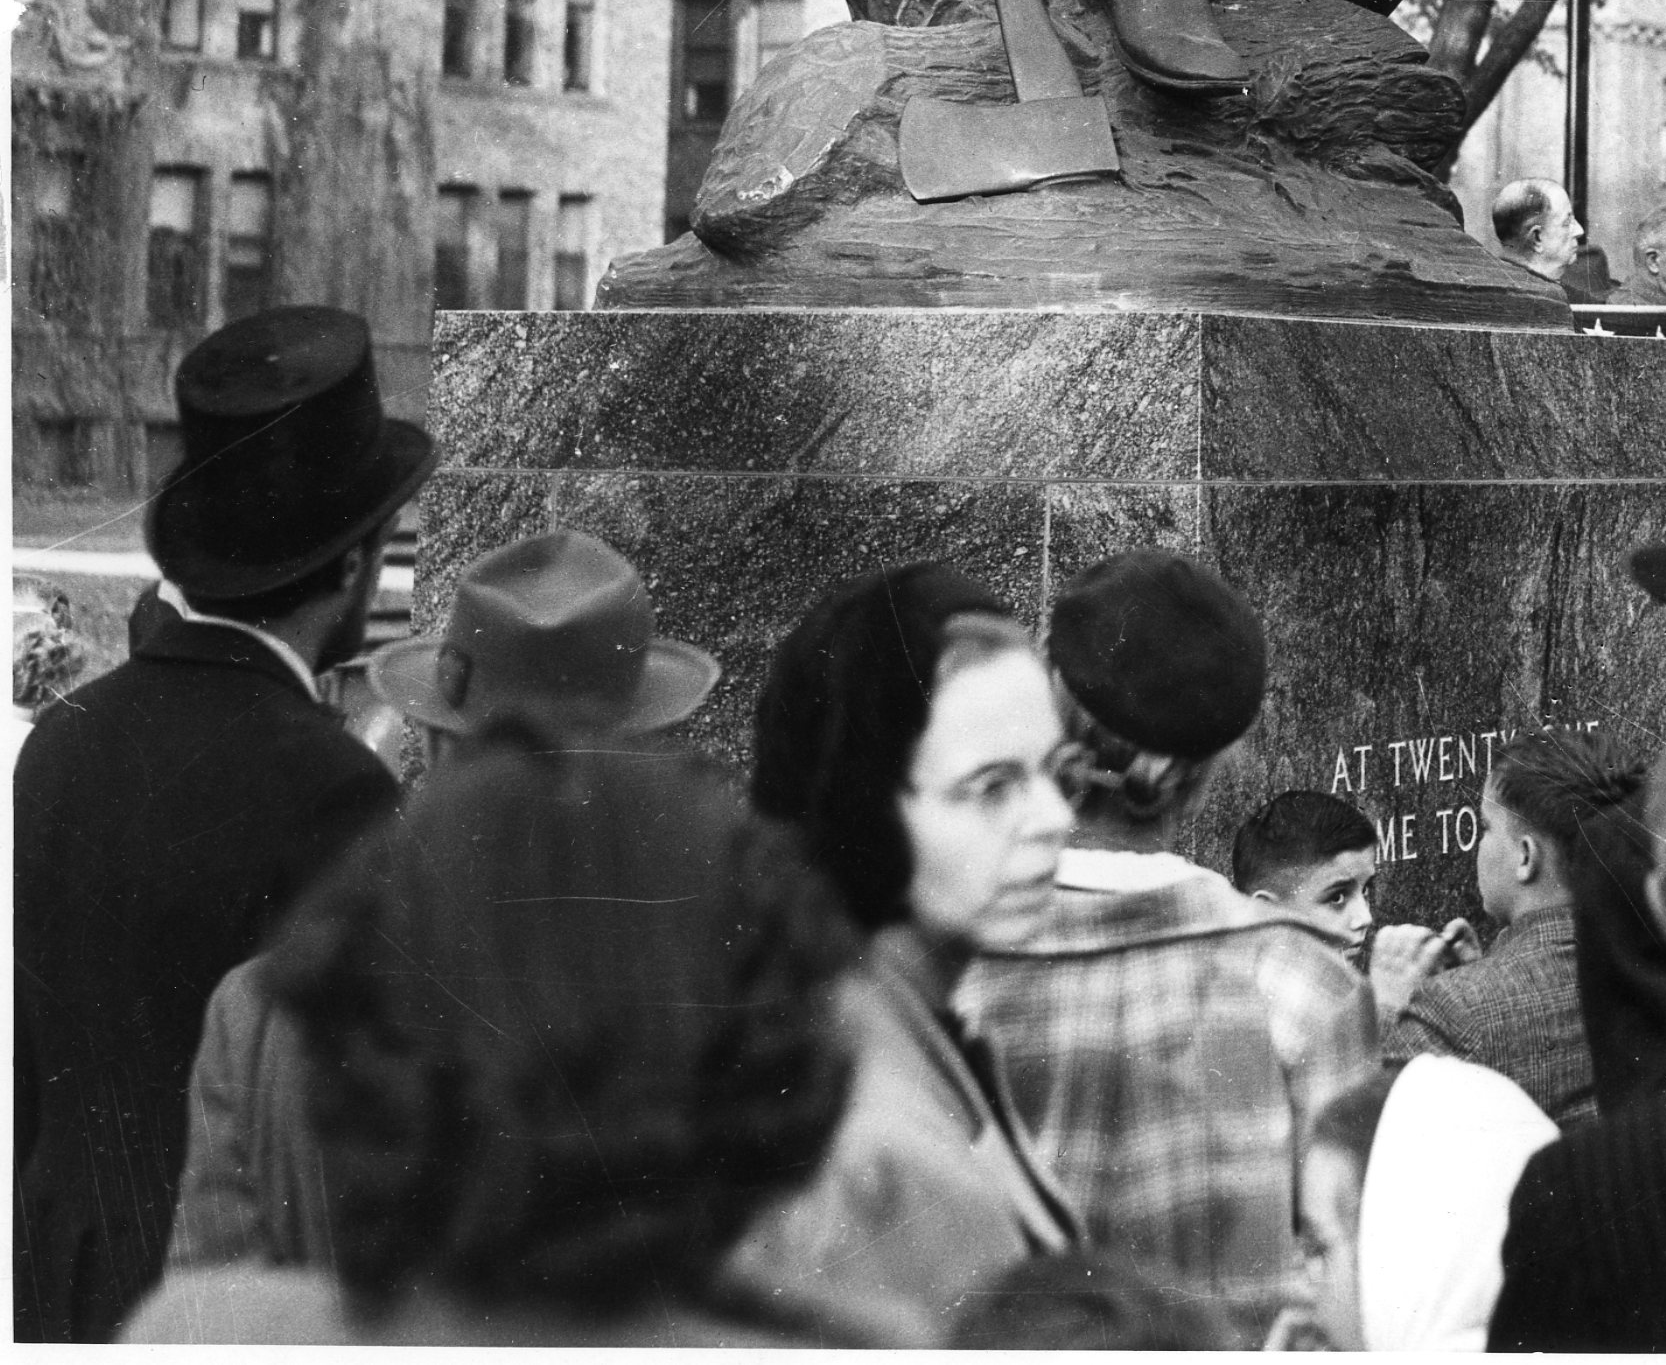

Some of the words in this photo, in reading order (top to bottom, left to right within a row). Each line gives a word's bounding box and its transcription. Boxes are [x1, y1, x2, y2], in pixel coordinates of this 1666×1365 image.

[1331, 745, 1373, 794] AT
[1375, 815, 1418, 864] ME
[1436, 806, 1478, 854] TO
